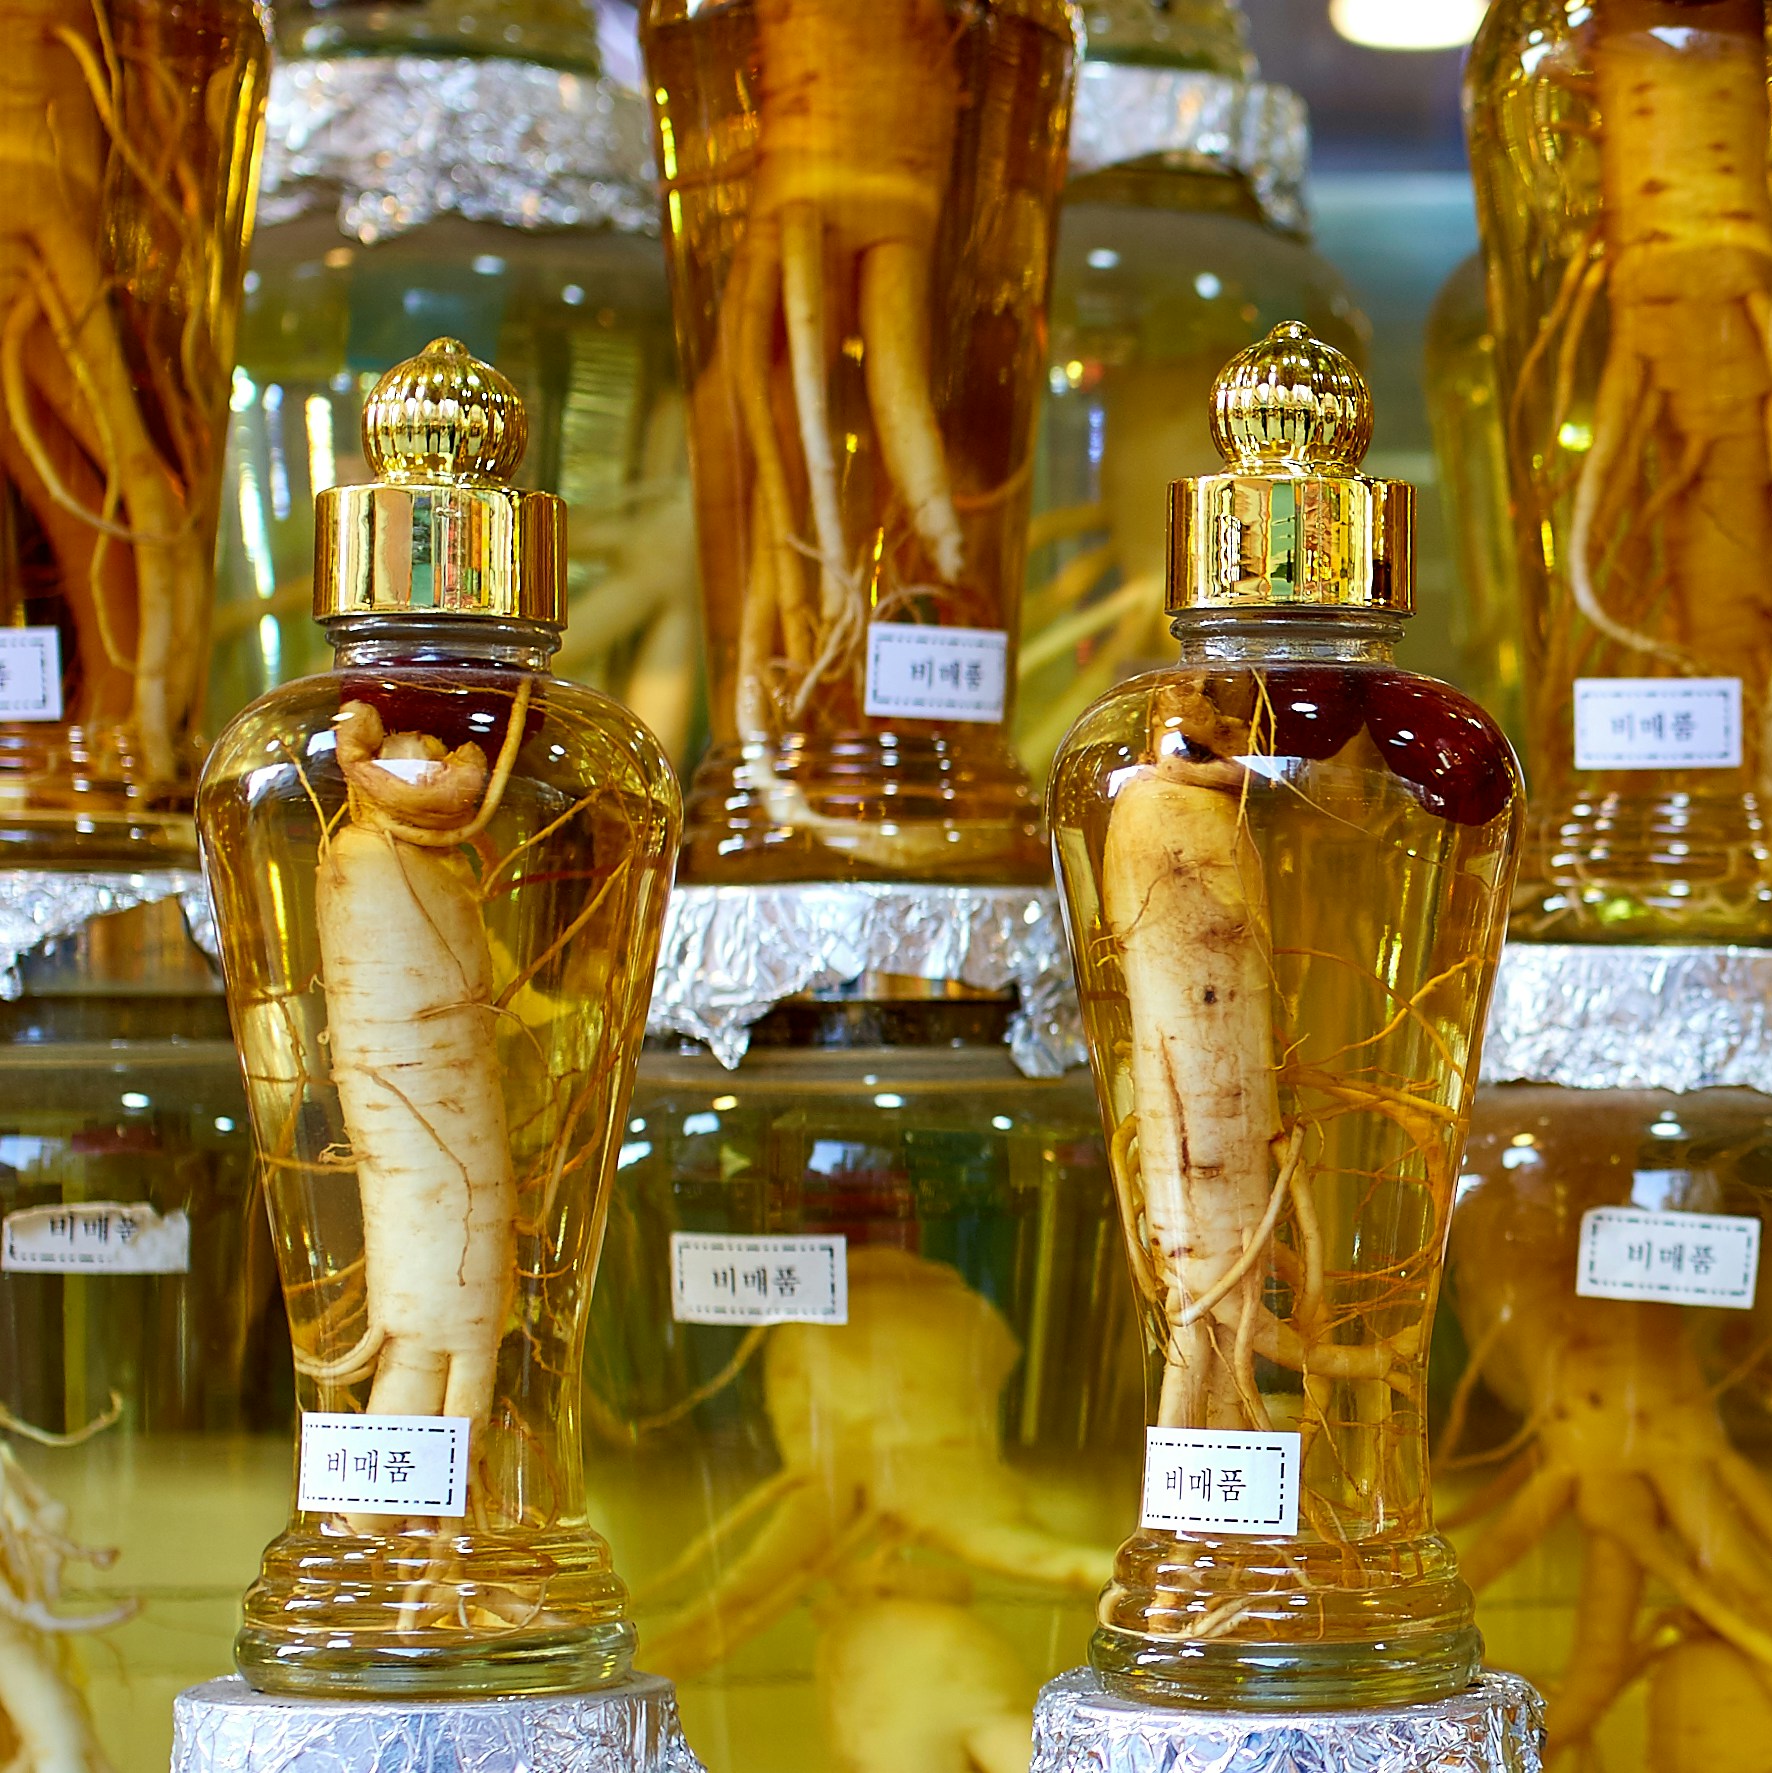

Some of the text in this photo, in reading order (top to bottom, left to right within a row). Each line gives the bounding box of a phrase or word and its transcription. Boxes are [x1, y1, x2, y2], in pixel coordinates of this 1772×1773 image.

[910, 656, 984, 692] 비매품
[1611, 708, 1698, 744] 비매품
[1628, 1241, 1716, 1277] 비매품
[712, 1265, 801, 1297] 비매품
[328, 1448, 416, 1484] 비매품
[1165, 1466, 1247, 1503] 비매품
